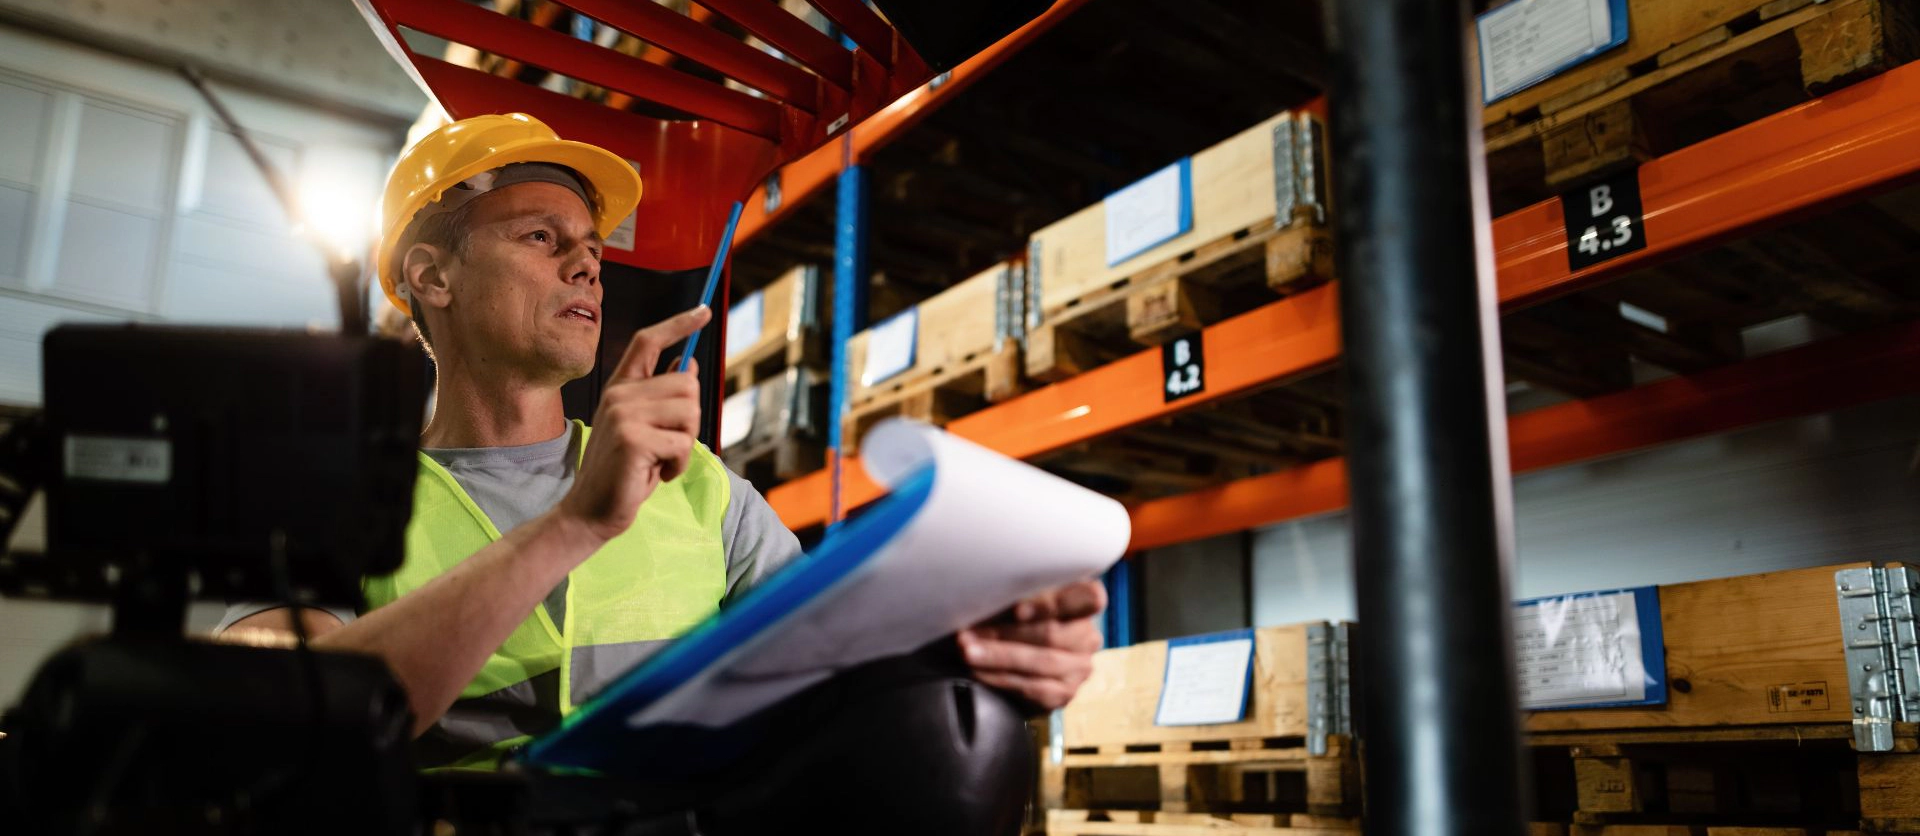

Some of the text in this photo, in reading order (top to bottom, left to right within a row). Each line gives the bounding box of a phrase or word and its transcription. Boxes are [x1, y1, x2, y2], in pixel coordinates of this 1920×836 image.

[1590, 185, 1613, 217] B
[1578, 214, 1632, 255] 4.3
[1174, 339, 1191, 367] B
[1167, 364, 1201, 394] 4.2
